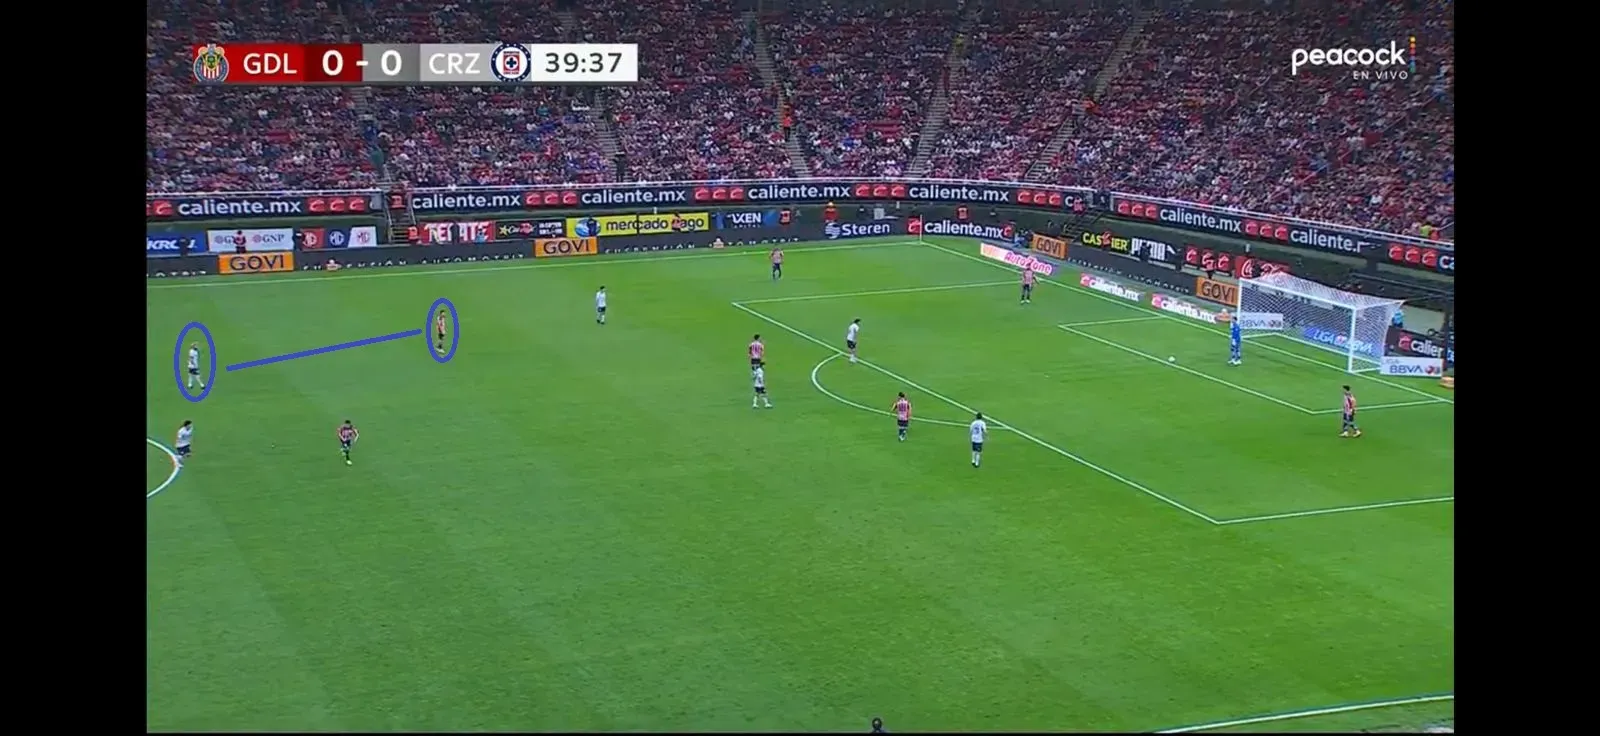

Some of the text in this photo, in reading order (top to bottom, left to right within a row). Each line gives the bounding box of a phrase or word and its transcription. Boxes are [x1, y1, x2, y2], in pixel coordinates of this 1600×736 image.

[581, 189, 686, 205] caliente.mx
[748, 184, 850, 201] caliente.mx
[909, 184, 1009, 202] caliente.mx
[178, 198, 301, 216] caliente.mx
[412, 193, 521, 210] caliente.mx
[606, 216, 705, 231] mercado ago
[1159, 205, 1242, 233] caliente.mx
[841, 222, 890, 237] Steren
[924, 220, 1003, 239] caliente.mx
[544, 239, 590, 255] GOVI
[1036, 237, 1061, 256] GOVI
[1082, 232, 1128, 252] CASIER
[229, 254, 285, 271] GOVI
[1201, 281, 1235, 303] GOVI
[1389, 364, 1423, 374] BBVA
